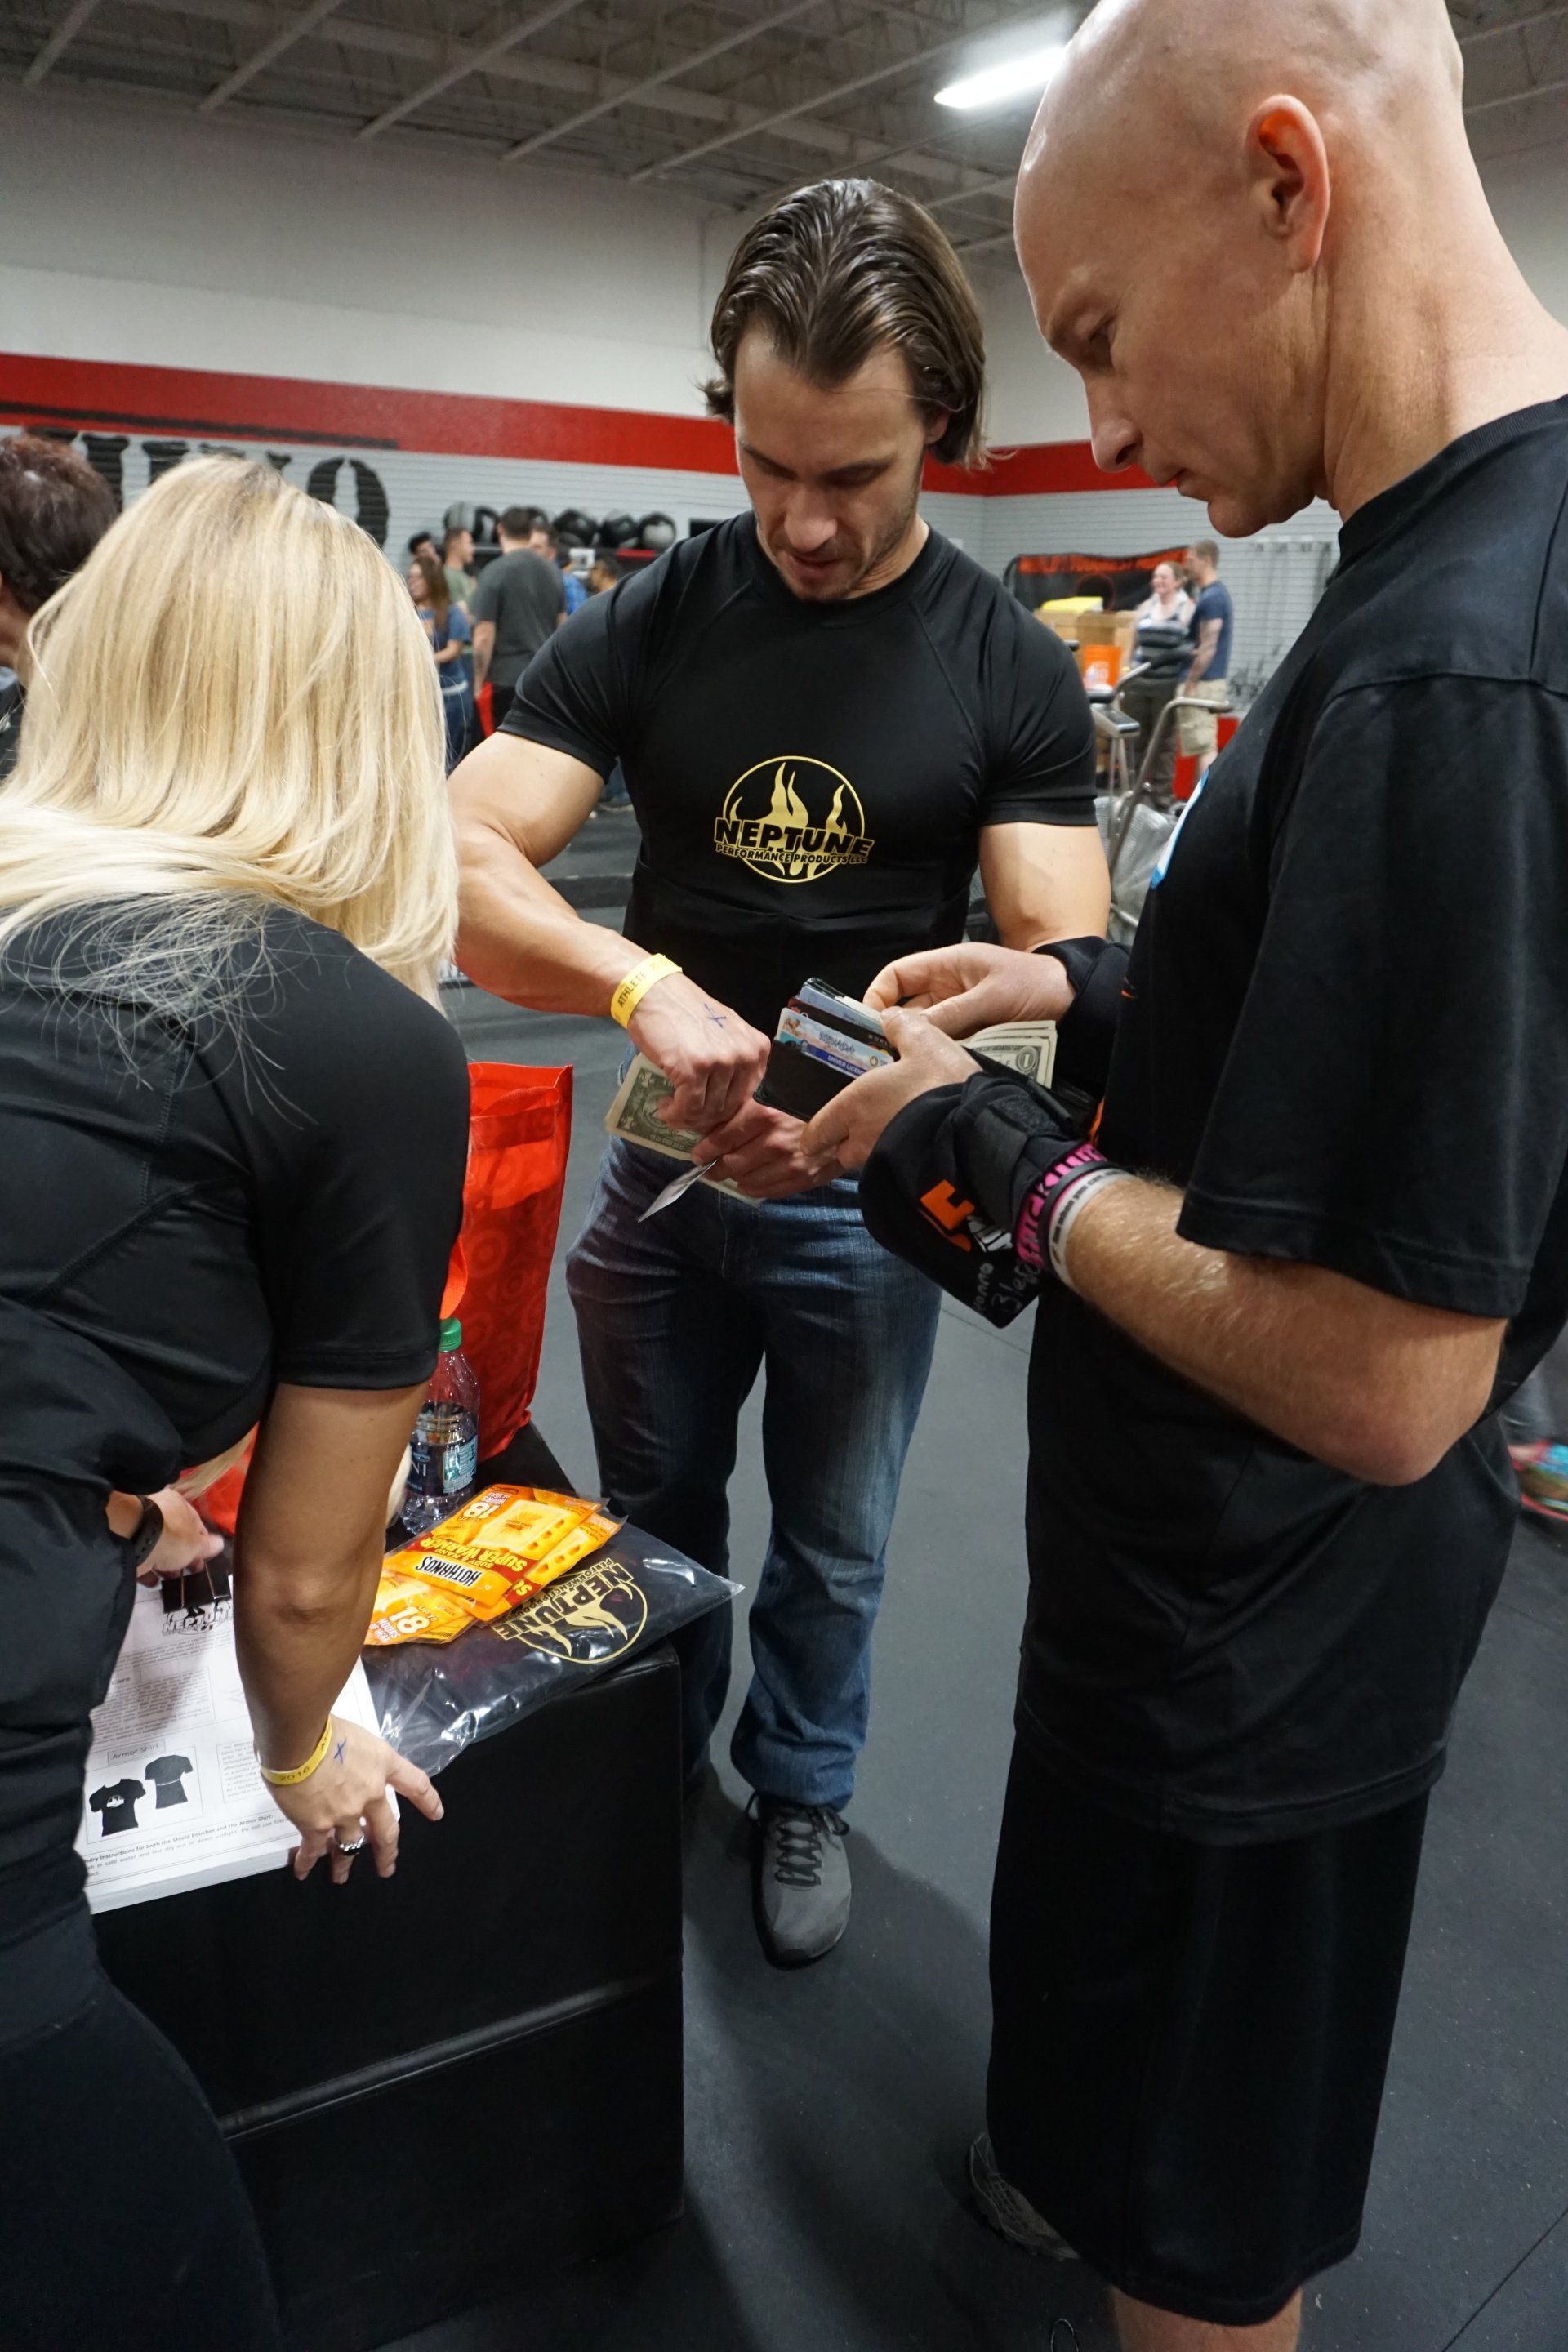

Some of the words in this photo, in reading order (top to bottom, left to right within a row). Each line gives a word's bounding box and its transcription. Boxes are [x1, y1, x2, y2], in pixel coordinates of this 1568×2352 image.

[715, 817, 875, 857] NEPTUNE
[715, 843, 791, 863] PERFORMANCE
[793, 853, 848, 864] PRODUCTS
[617, 972, 647, 1008] ATHLETE
[827, 1055, 847, 1067] DRIVER
[846, 1062, 866, 1075] LICEN
[1058, 1199, 1075, 1226] when
[463, 1502, 500, 1519] 18
[420, 1537, 481, 1559] WARMER
[434, 1548, 461, 1560] HAND
[469, 1559, 494, 1569] BODY
[478, 1549, 528, 1572] SUPER
[549, 1557, 615, 1598] PERFORMANCE
[418, 1605, 430, 1614] UP
[492, 1563, 634, 1641] NEPTUNE
[162, 1610, 230, 1635] NEPTUN
[389, 1606, 430, 1634] 18
[113, 1749, 138, 1760] Armor
[140, 1744, 158, 1753] Shirt
[100, 1848, 135, 1861] Instructions
[145, 1841, 160, 1849] both
